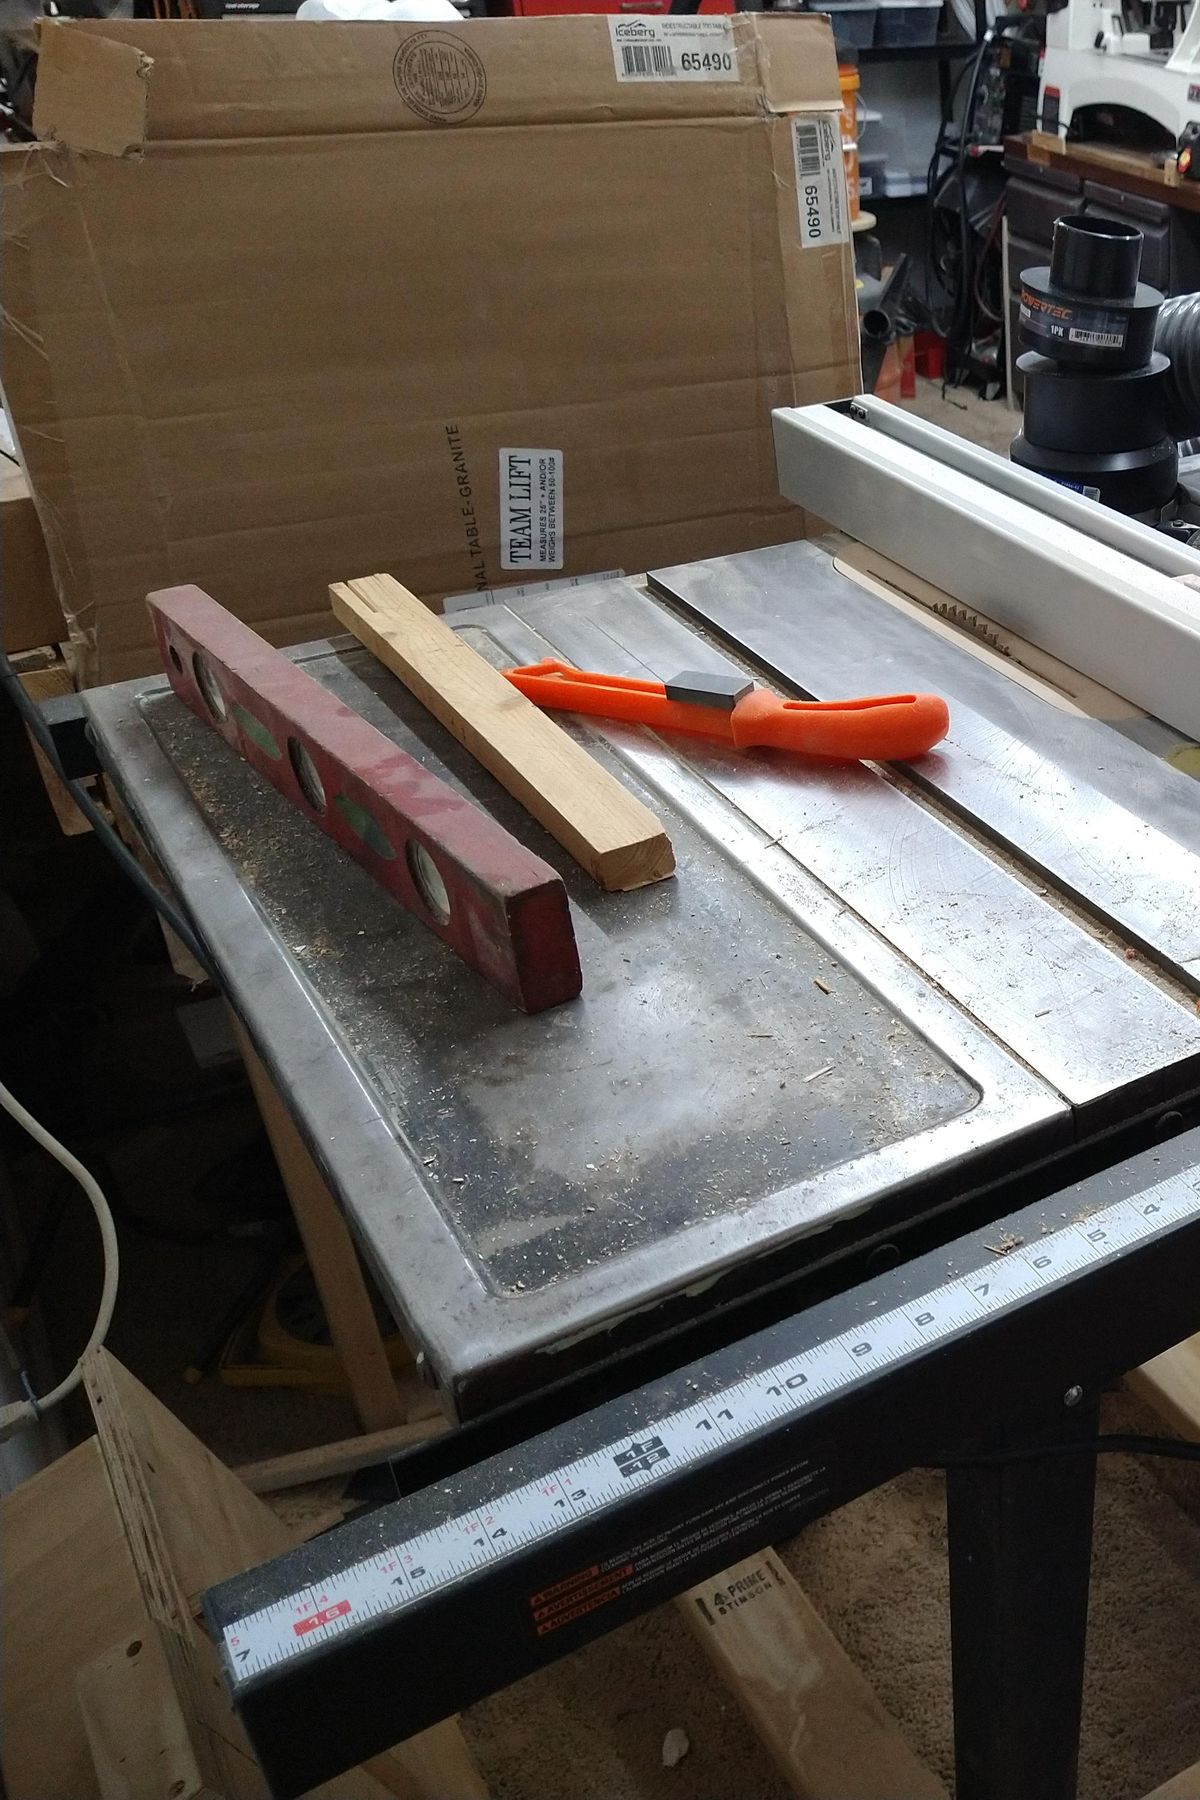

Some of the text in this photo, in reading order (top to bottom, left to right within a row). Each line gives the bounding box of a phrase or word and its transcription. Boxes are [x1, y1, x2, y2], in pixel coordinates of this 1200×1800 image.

[616, 27, 655, 38] Iceberg
[681, 53, 732, 71] 65490
[804, 185, 821, 238] 65490
[1051, 325, 1064, 337] 1PK
[539, 458, 547, 492] AND/OR
[509, 455, 531, 563] TEAM LIFT
[548, 488, 556, 529] BETWEEN
[548, 531, 556, 563] WEIGHS
[308, 1606, 340, 1625] 16
[391, 1566, 426, 1586] 15
[473, 1527, 508, 1547] 14
[554, 1488, 587, 1508] 13
[632, 1453, 661, 1471] 12
[695, 1408, 734, 1431] 11
[766, 1373, 808, 1396] 10
[851, 1342, 872, 1357] 9
[914, 1312, 935, 1326] 8
[974, 1283, 990, 1296] 7
[1032, 1256, 1052, 1269] 6
[1086, 1228, 1107, 1242] 5
[1143, 1203, 1161, 1216] 4
[231, 1441, 653, 1646] 5 1F 4 1F 3 1F 2 1F 1 1F
[726, 1568, 766, 1598] PRIME
